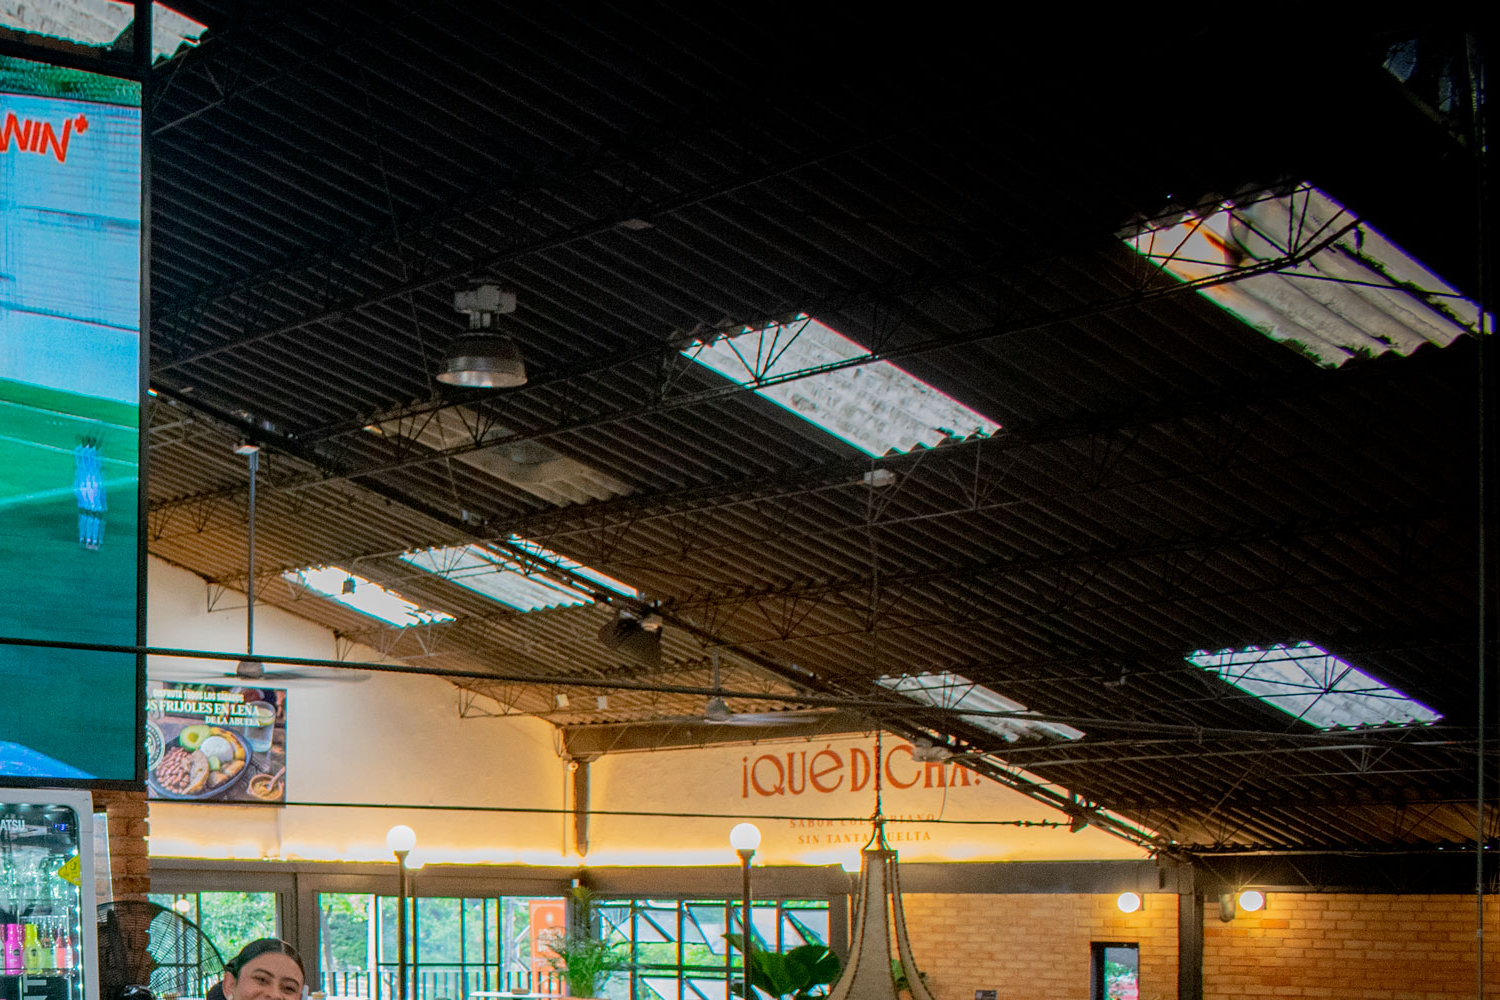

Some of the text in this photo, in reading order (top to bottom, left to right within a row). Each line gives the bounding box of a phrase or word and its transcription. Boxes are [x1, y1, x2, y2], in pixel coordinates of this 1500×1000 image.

[160, 700, 213, 715] FRIJOLES
[214, 703, 229, 716] EN
[231, 702, 260, 717] LEÑA
[884, 831, 931, 842] UELTA
